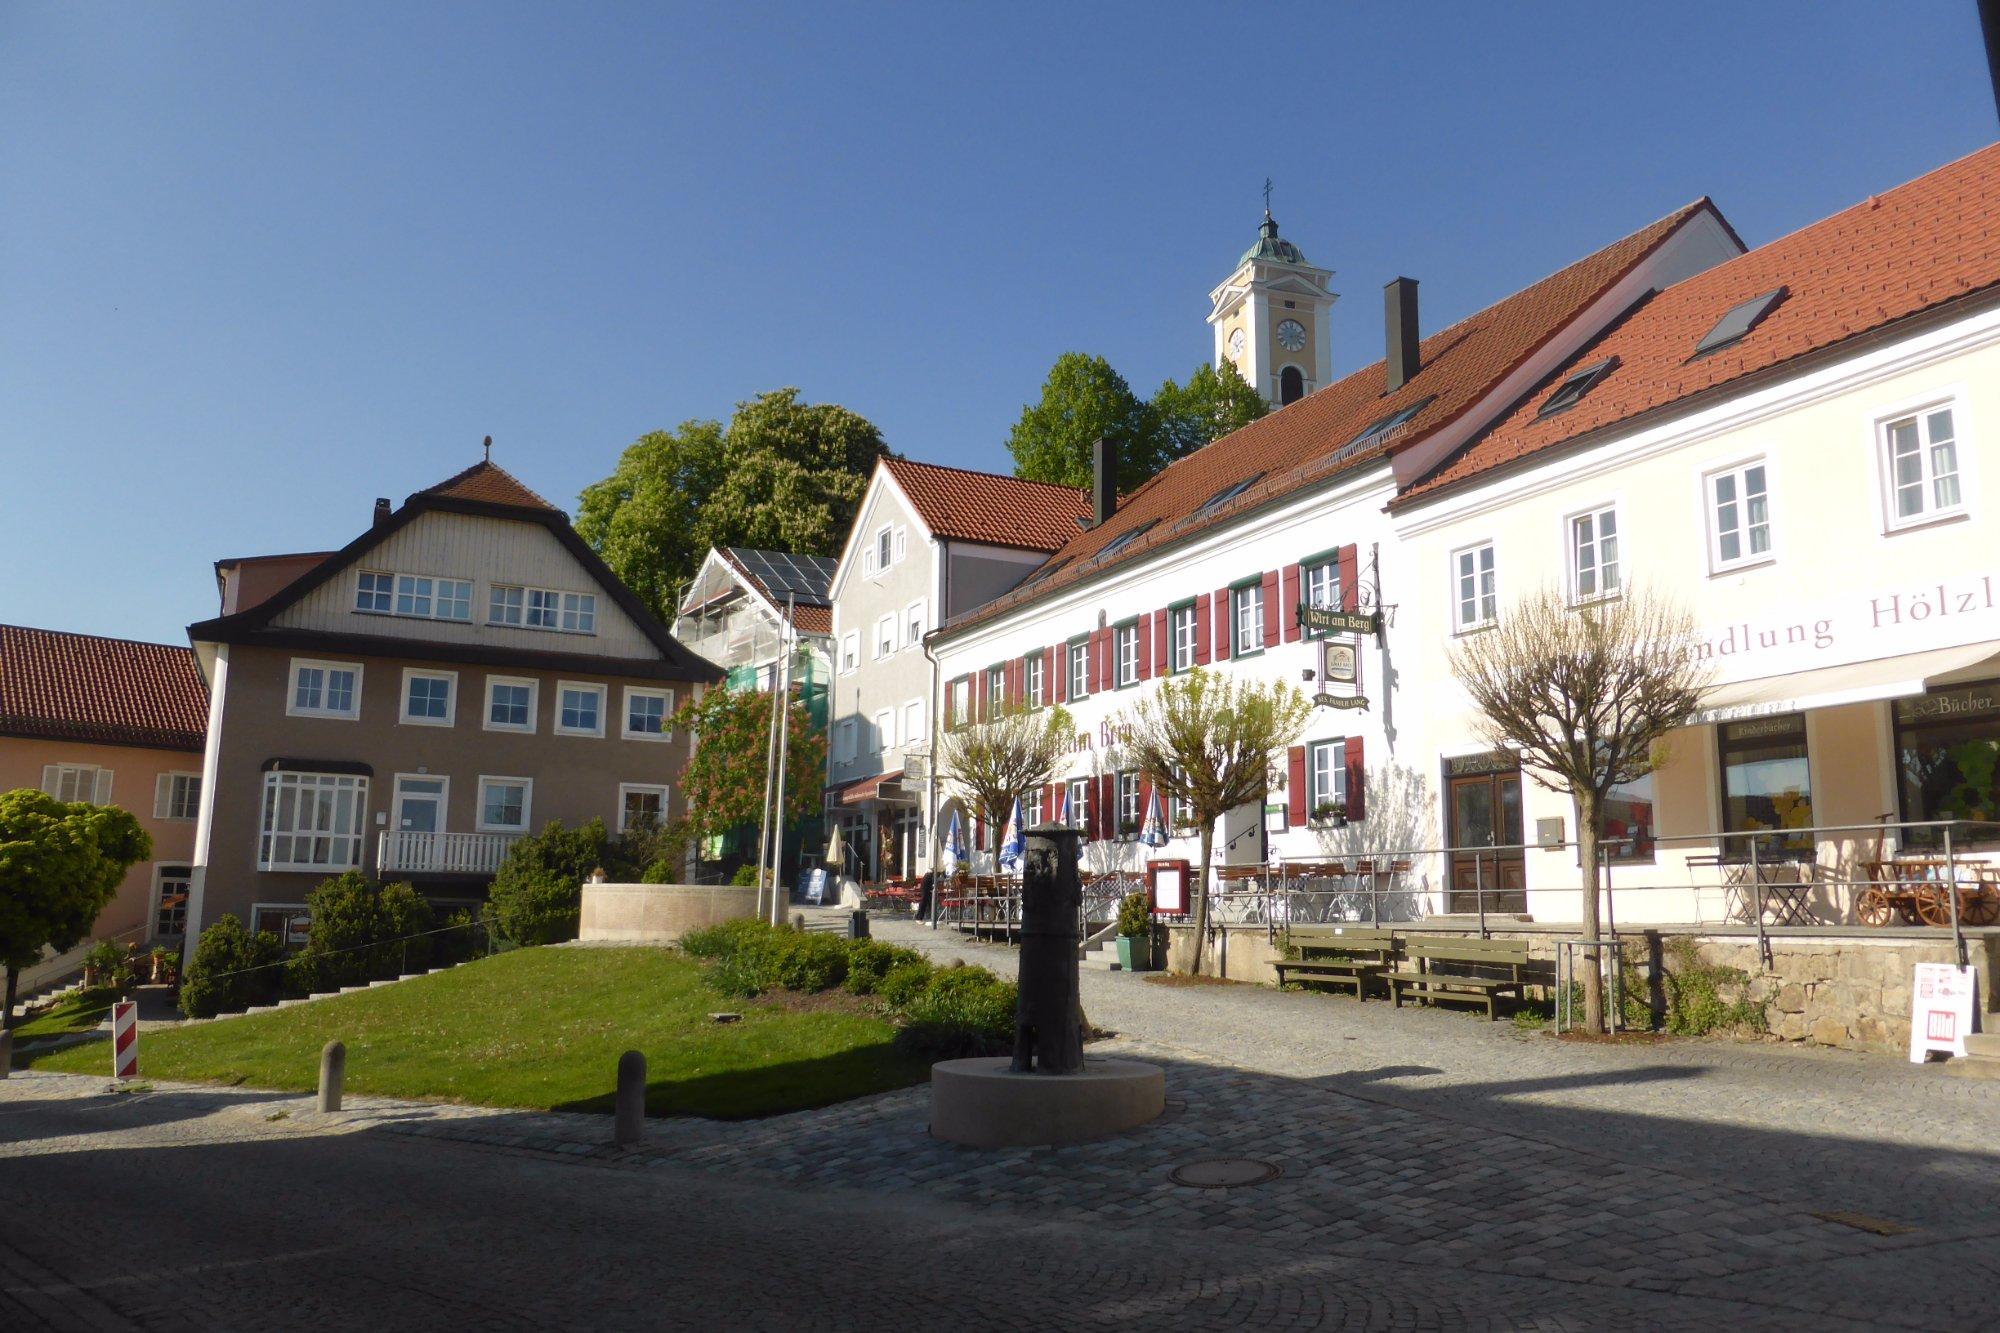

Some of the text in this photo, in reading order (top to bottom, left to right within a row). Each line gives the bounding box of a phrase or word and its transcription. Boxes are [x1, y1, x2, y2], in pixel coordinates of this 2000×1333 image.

[1870, 576, 1994, 628] Hölzl
[1310, 612, 1370, 632] Wirt am Berg
[1936, 691, 1993, 714] Bücher
